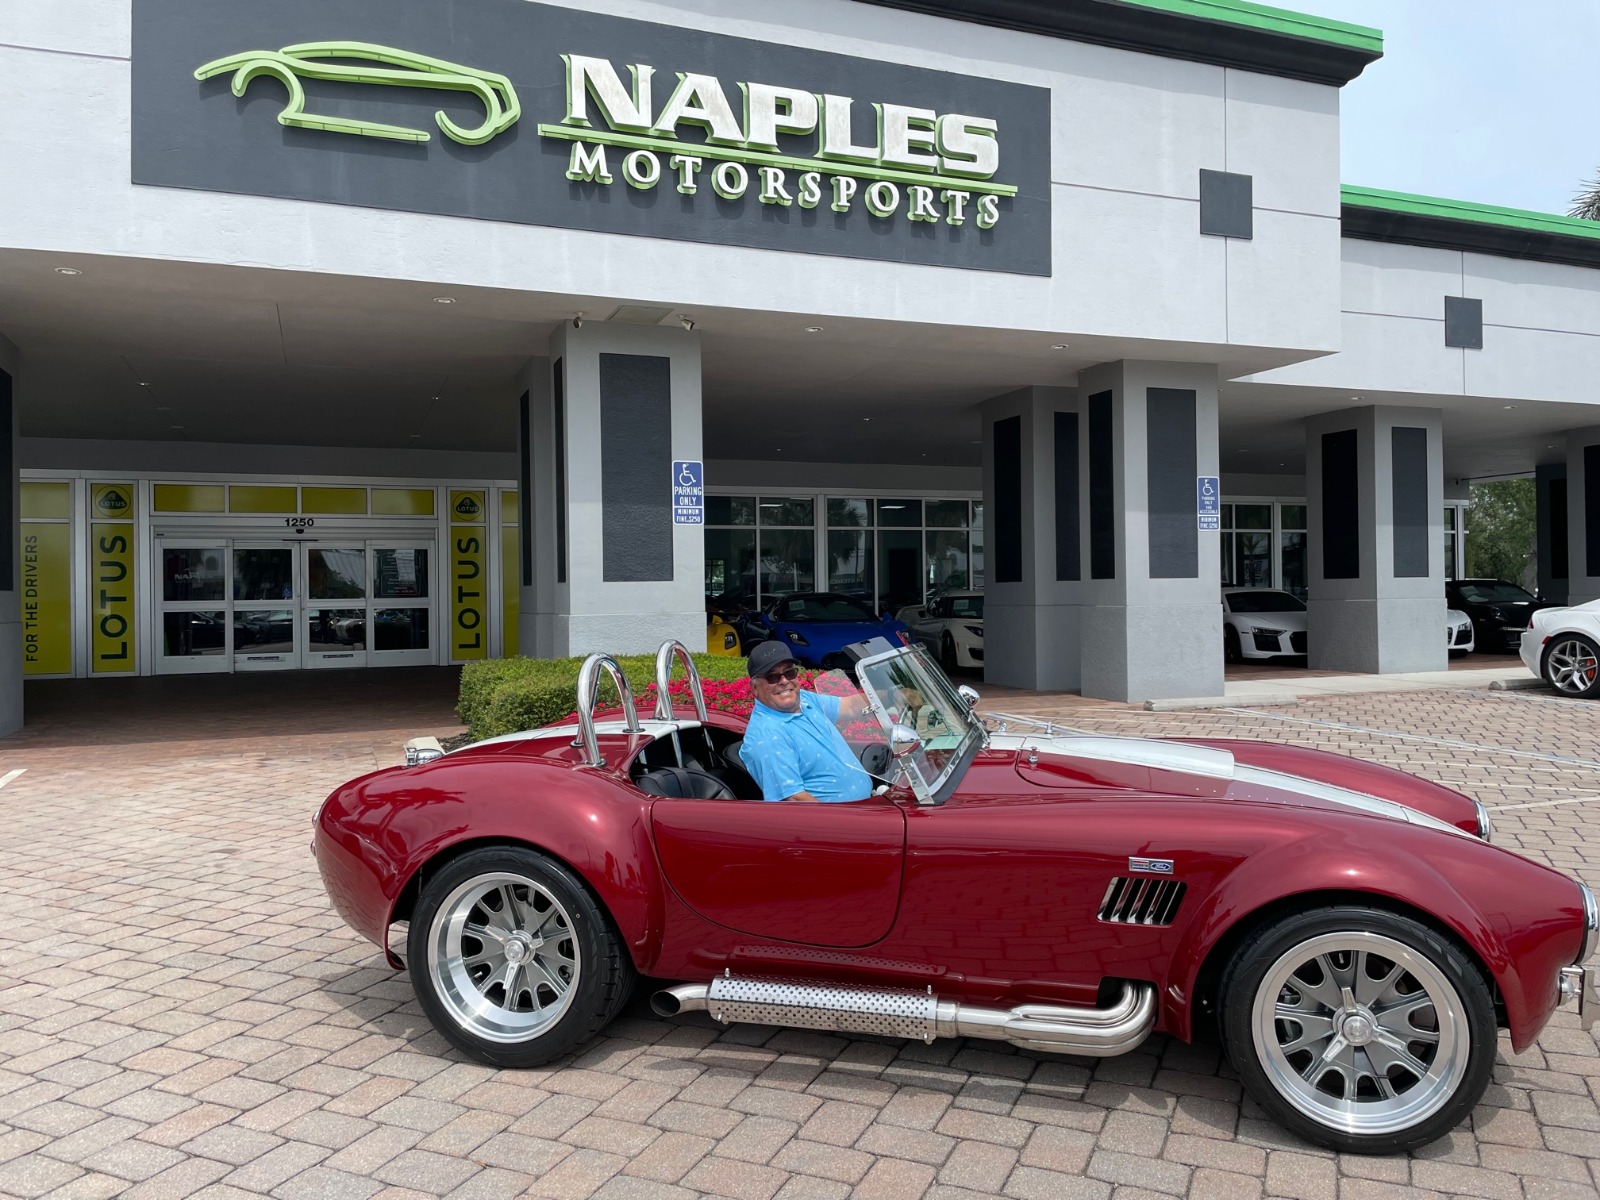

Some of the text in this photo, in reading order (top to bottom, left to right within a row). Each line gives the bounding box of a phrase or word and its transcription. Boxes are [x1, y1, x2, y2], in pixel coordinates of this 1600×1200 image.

[560, 54, 998, 179] NAPLES
[566, 141, 999, 229] MOTORSPORTS
[285, 517, 315, 527] 1250
[674, 486, 701, 495] PARKING
[680, 497, 696, 505] ONLY
[24, 535, 39, 662] FOR THE DRIVERS
[100, 535, 127, 660] LOTUS
[457, 537, 480, 649] LOTUS
